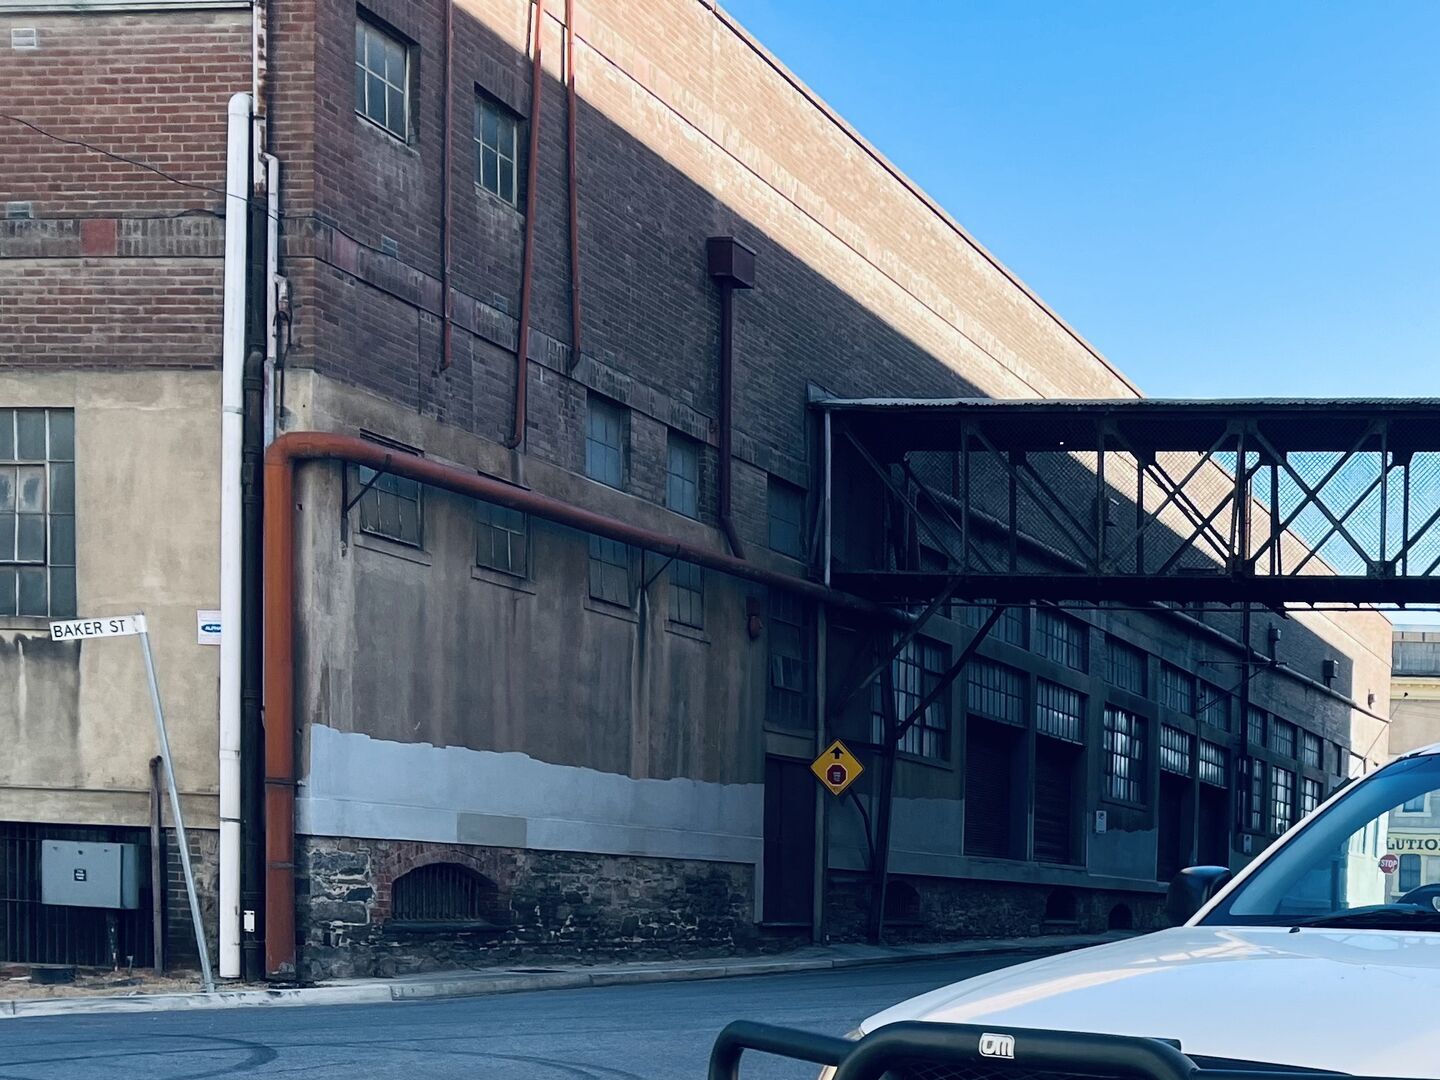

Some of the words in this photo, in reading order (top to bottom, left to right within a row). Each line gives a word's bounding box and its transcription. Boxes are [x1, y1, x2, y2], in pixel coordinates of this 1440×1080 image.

[53, 621, 103, 639] BAKER
[109, 619, 126, 633] ST
[1380, 858, 1398, 868] STOP
